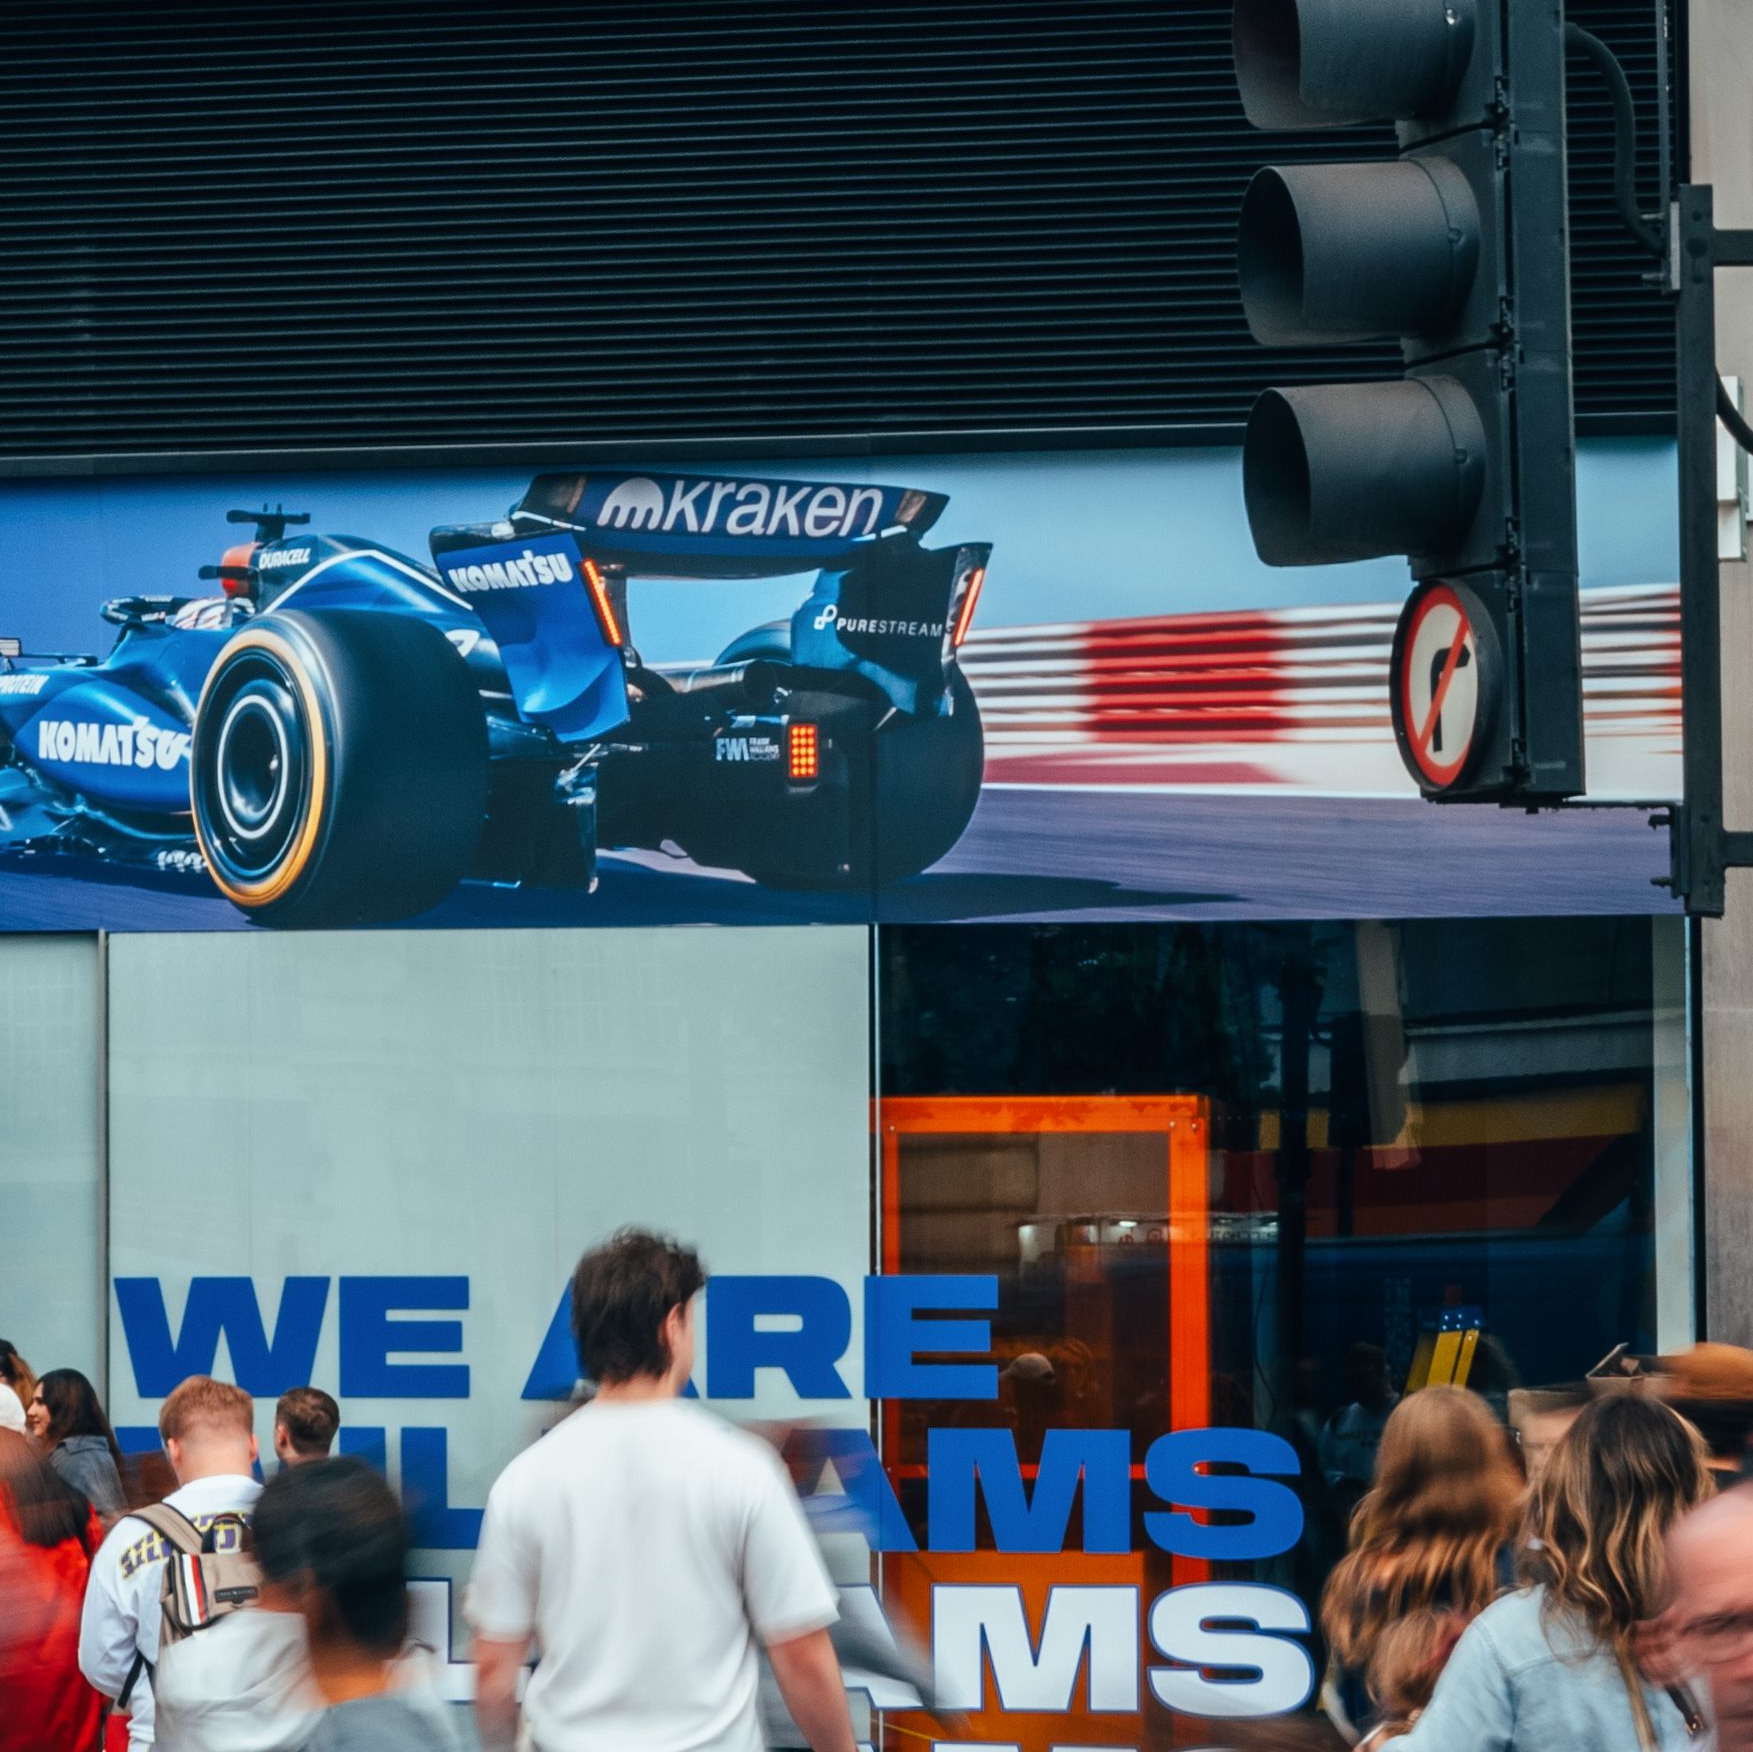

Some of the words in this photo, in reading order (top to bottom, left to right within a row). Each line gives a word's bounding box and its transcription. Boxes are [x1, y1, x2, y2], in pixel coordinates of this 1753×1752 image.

[258, 547, 311, 570] DURACELL
[447, 549, 574, 593] KOMATSU
[836, 617, 943, 637] PURESTREAM
[38, 715, 193, 771] KOMATSU
[113, 1276, 470, 1399] WE
